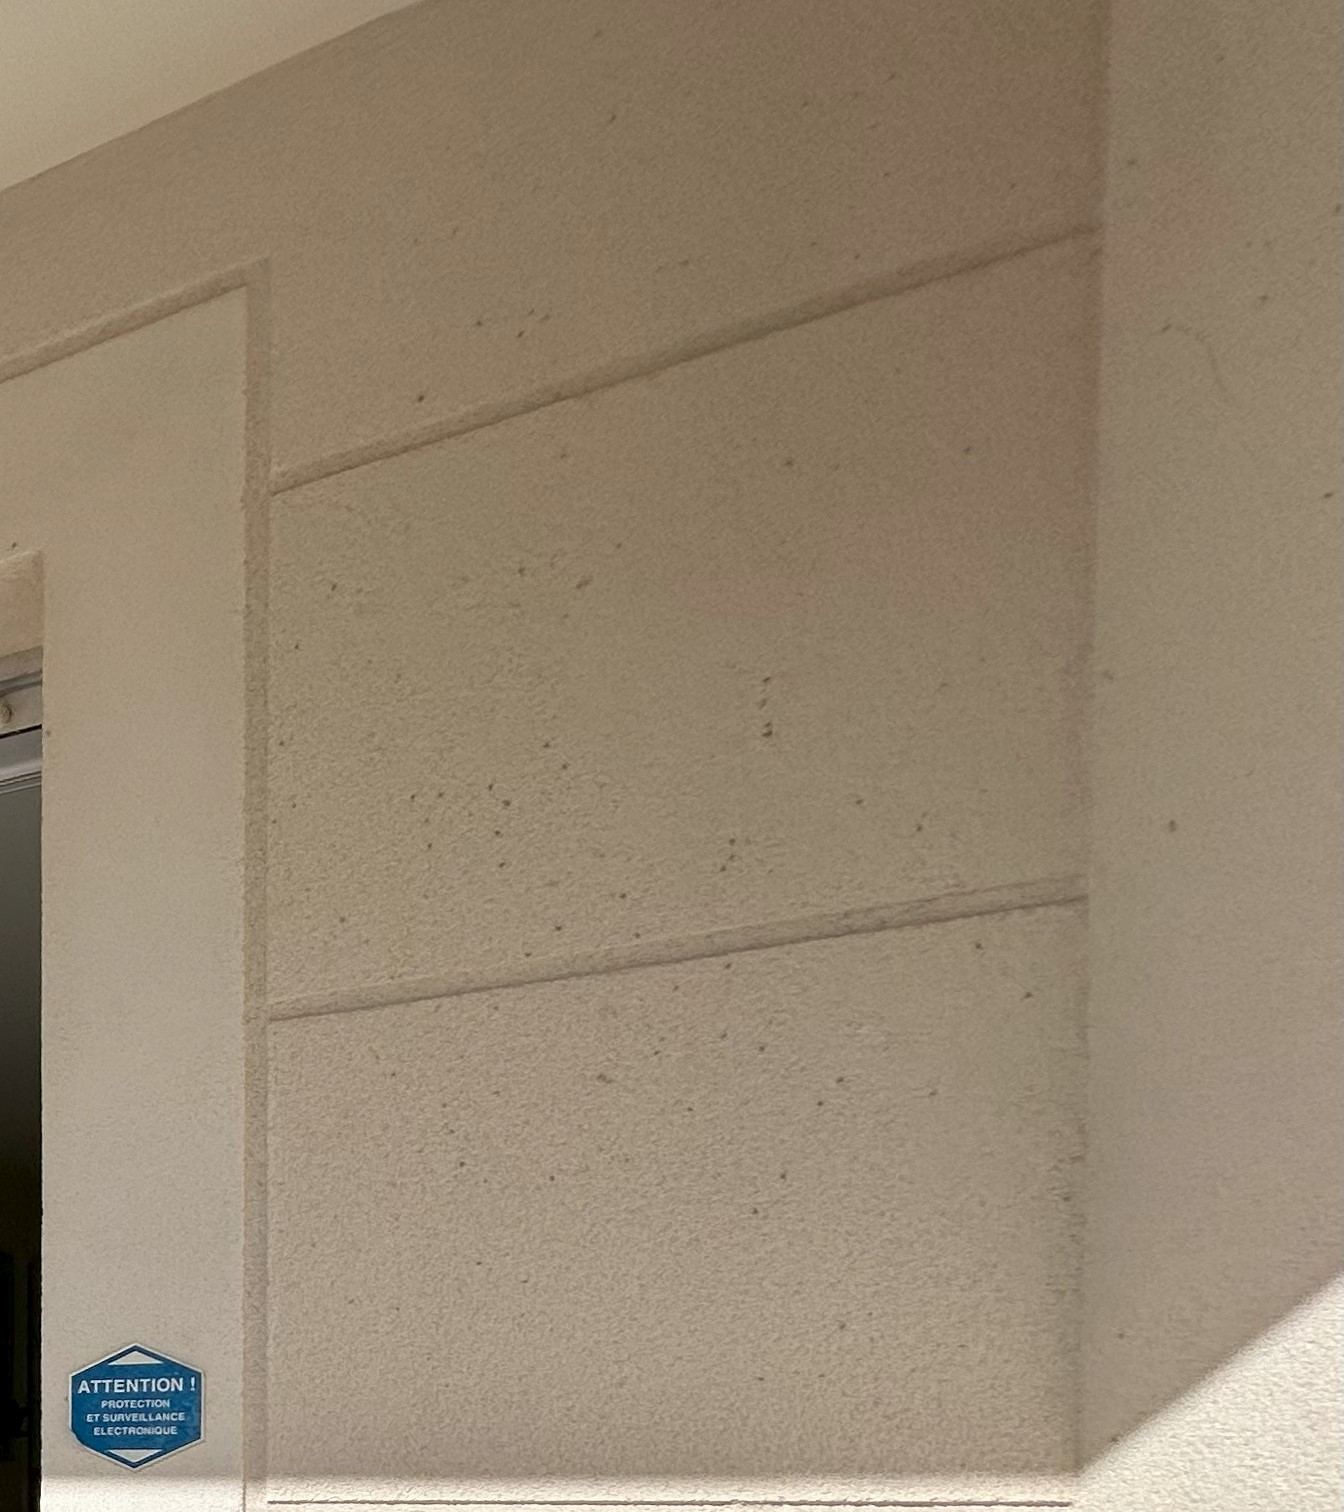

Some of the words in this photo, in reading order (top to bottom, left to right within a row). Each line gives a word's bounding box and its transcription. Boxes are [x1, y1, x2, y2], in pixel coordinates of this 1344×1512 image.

[77, 1377, 184, 1394] ATTENTION
[190, 1377, 196, 1391] !
[101, 1399, 170, 1409] PROTECTION
[86, 1413, 100, 1422] ET
[102, 1412, 186, 1422] SURVEILLANCE
[93, 1426, 178, 1436] ELECTRONIQUE
